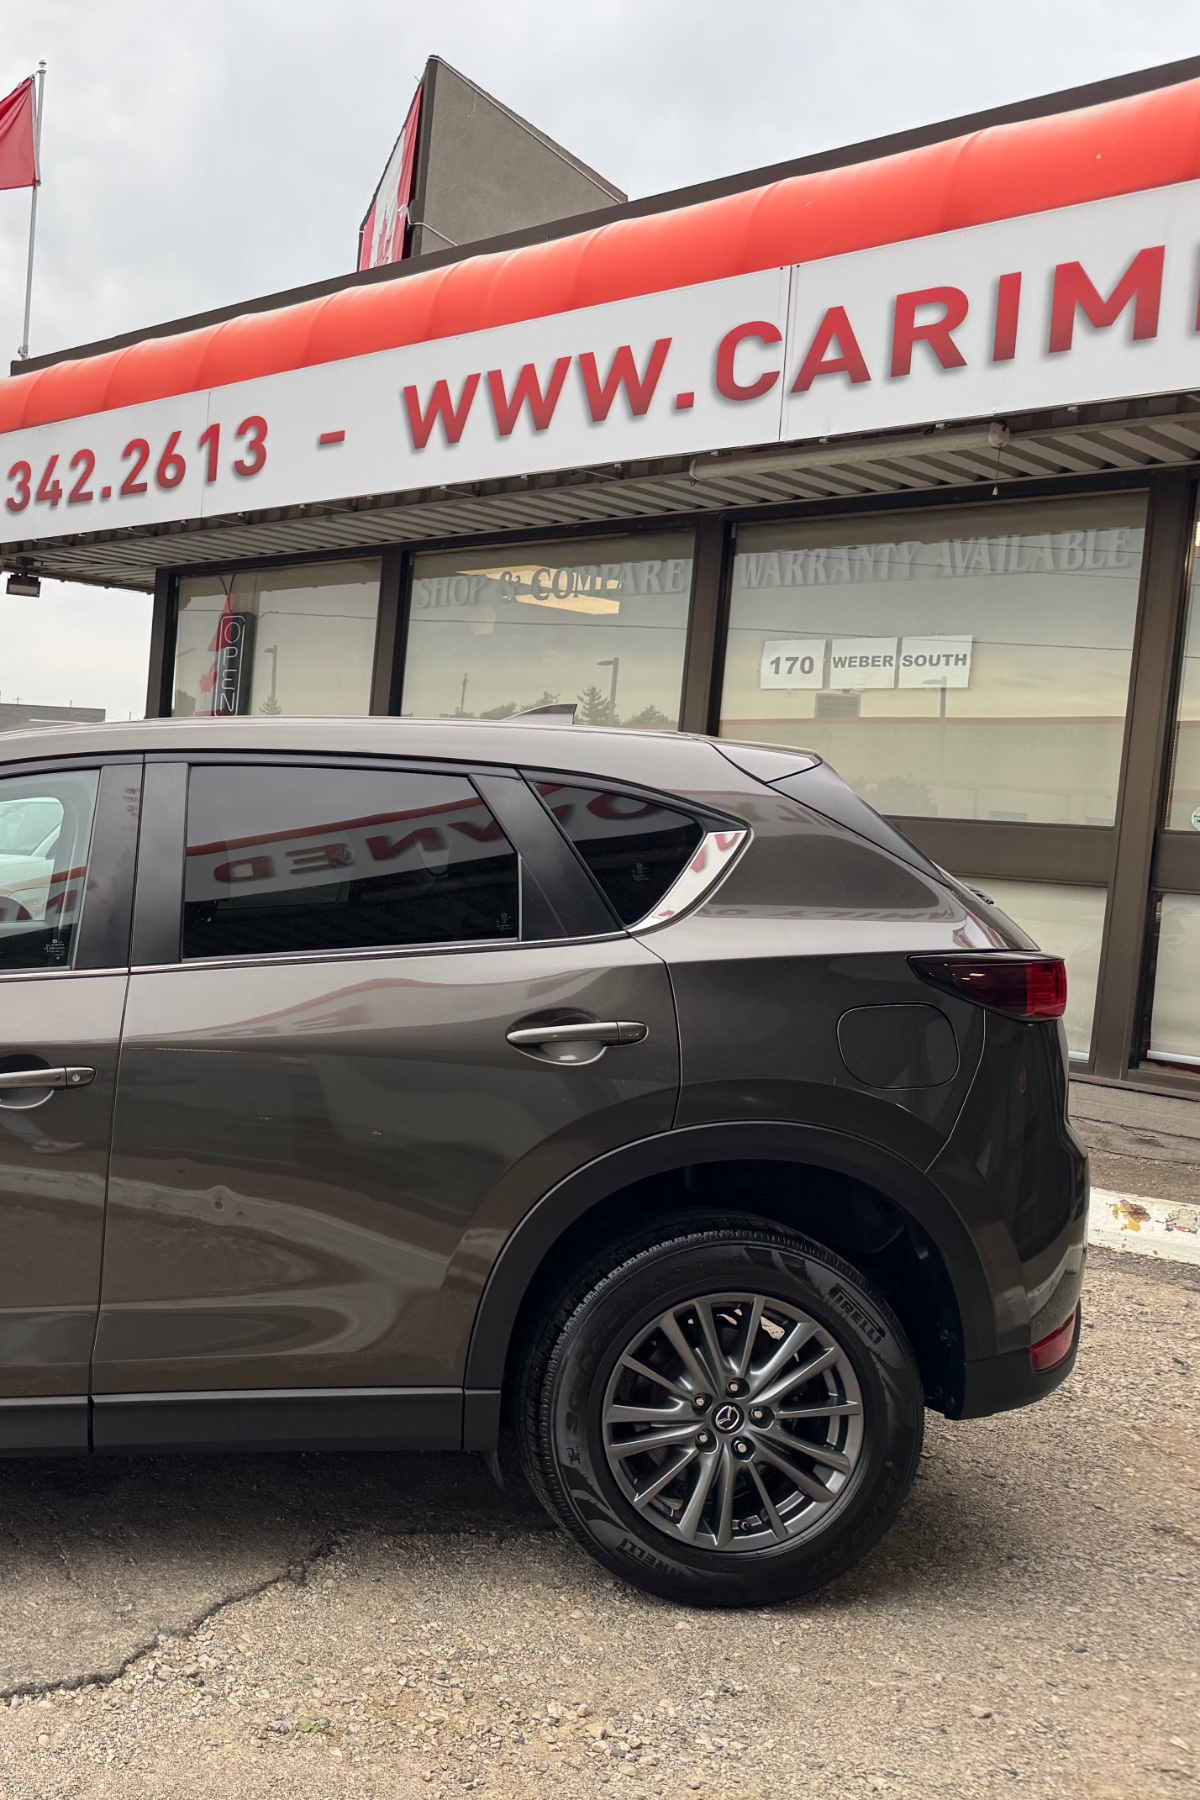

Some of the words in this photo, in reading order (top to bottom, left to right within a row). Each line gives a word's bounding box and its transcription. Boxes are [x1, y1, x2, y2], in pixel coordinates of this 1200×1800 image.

[403, 244, 1200, 450] WWW.CARIM
[415, 574, 488, 609] SHOP
[499, 571, 521, 601] &
[530, 558, 686, 601] COMPARE
[739, 541, 919, 589] WARRANTY
[936, 526, 1132, 579] AVAILABLE
[219, 621, 241, 712] OPEN
[769, 655, 815, 675] 170
[832, 654, 894, 669] WEBER
[901, 652, 968, 668] SOUTH
[828, 1282, 887, 1345] PIRELLI
